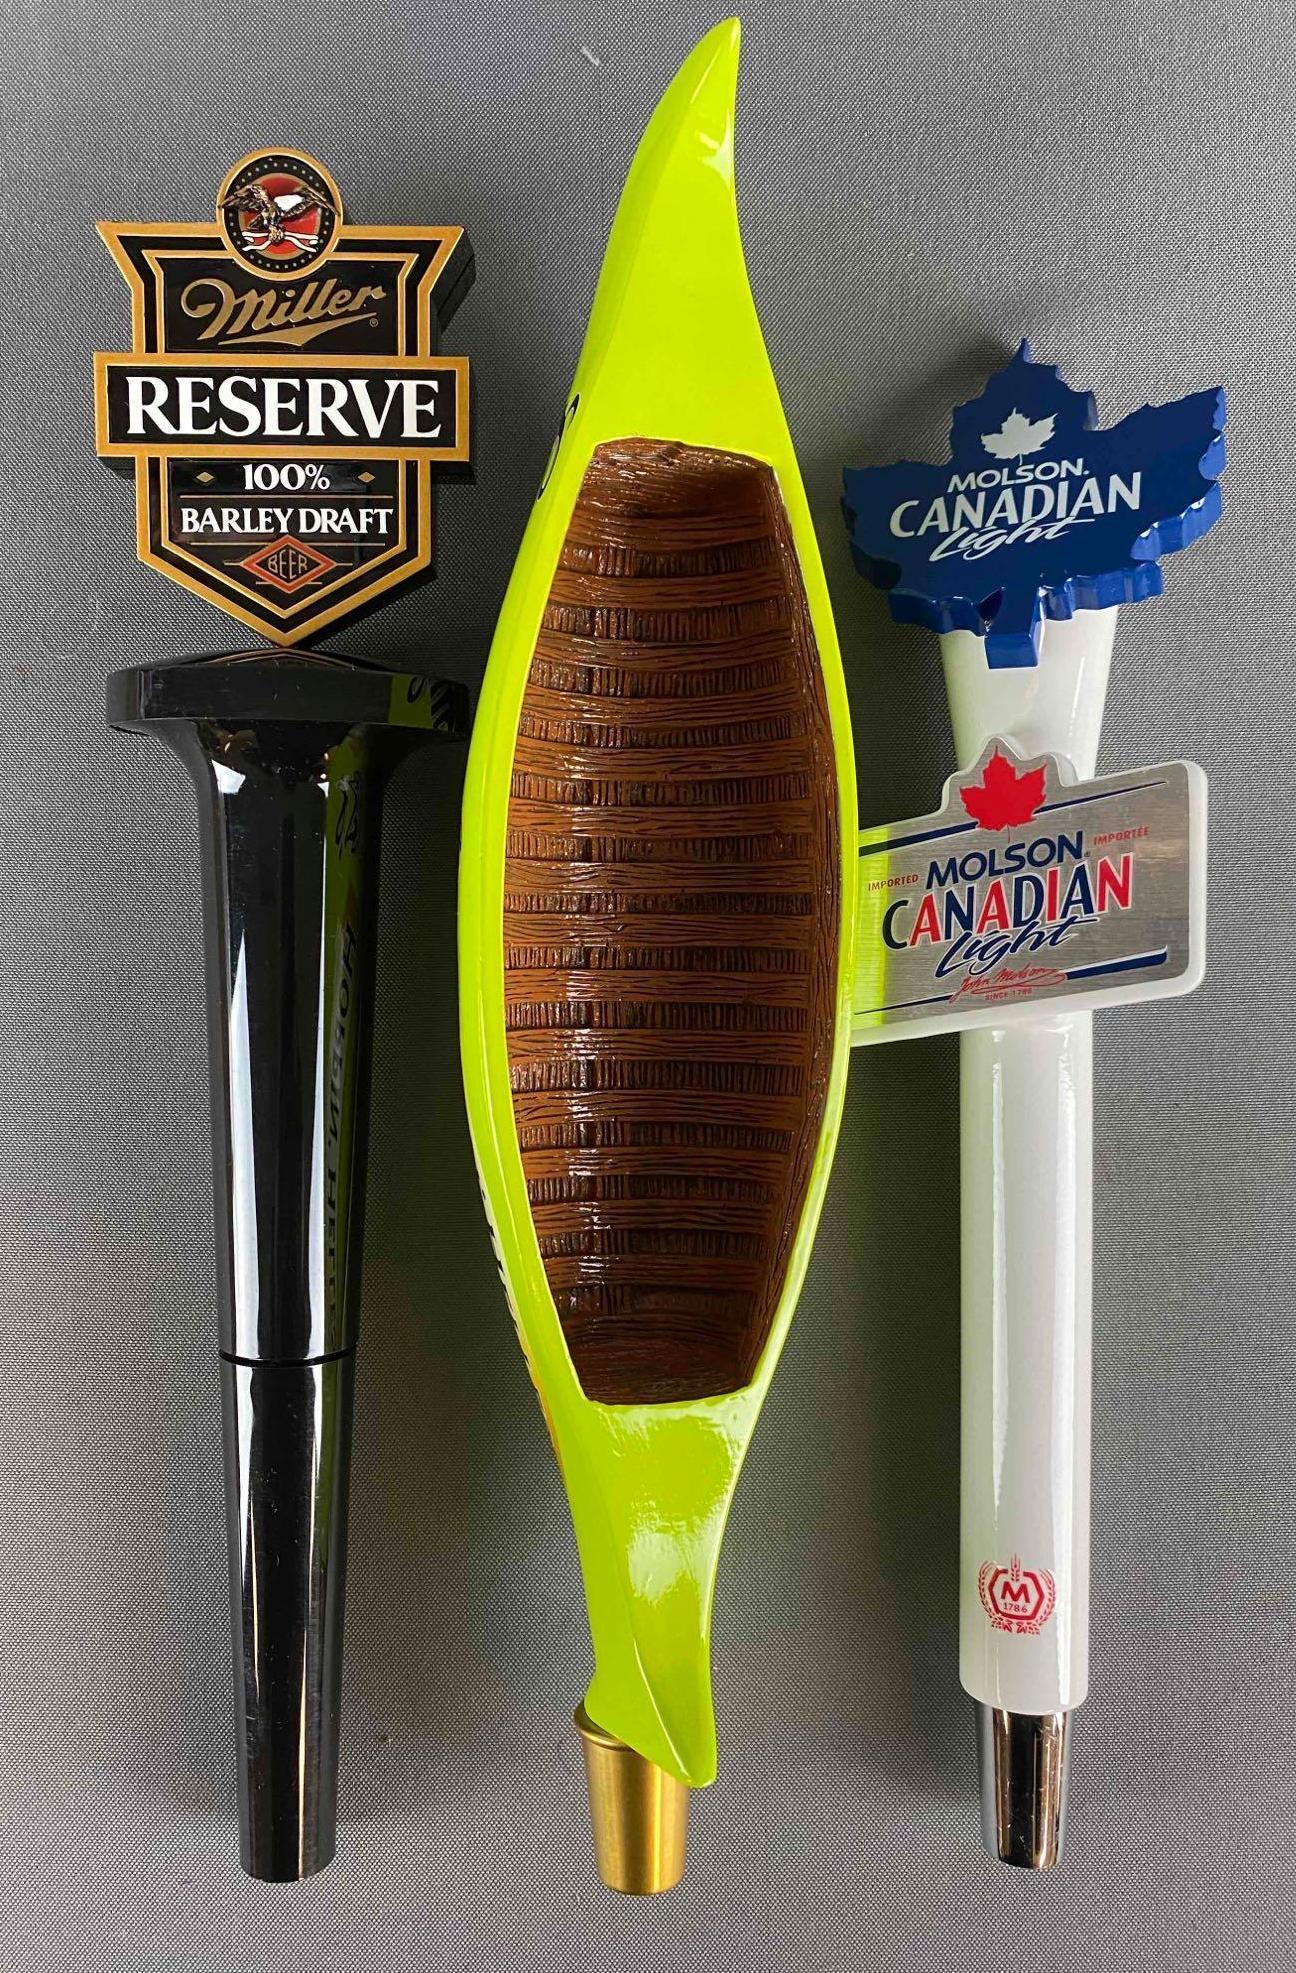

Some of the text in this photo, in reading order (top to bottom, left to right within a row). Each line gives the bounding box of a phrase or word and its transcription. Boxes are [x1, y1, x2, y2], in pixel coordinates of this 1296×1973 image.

[180, 278, 388, 342] Miller
[126, 375, 442, 439] RESERVE
[243, 463, 331, 491] 100%
[181, 507, 394, 536] BARLEY DRAFT
[889, 471, 1142, 538] CANADIAN
[928, 516, 1096, 562] Light
[267, 553, 309, 576] BEER
[926, 831, 1085, 890] MOLSON
[868, 874, 919, 891] IMPORTED
[881, 853, 1134, 951] CANADIAN
[933, 915, 1100, 979] Light
[985, 990, 1009, 1001] SINCE
[1000, 1581, 1031, 1603] M
[1003, 1602, 1028, 1614] 1786
